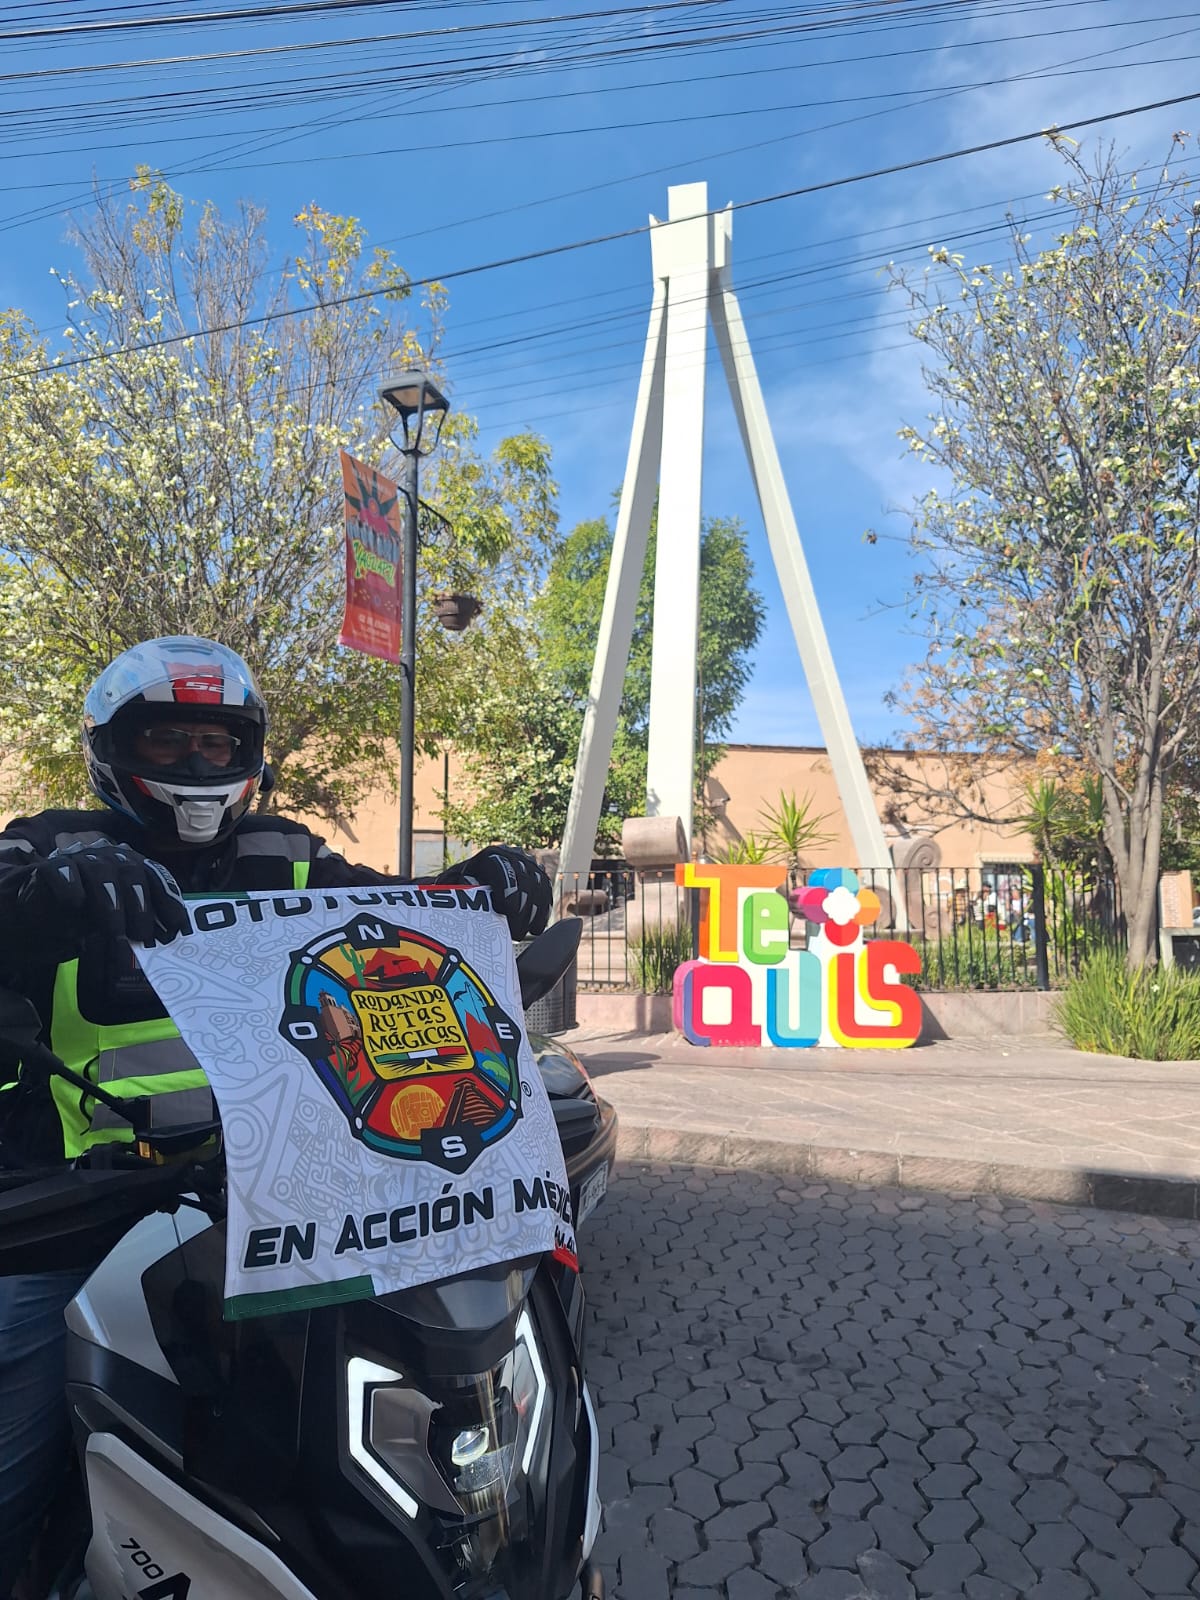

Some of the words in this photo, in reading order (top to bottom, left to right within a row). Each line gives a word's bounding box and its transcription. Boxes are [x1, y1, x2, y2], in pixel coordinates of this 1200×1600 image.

[674, 863, 788, 964] Te
[357, 924, 385, 941] N
[292, 1021, 318, 1039] O
[494, 1022, 515, 1040] E
[441, 1135, 467, 1158] S
[243, 1222, 316, 1269] EN
[334, 1183, 495, 1255] ACCIÓN
[512, 1170, 574, 1225] MÉXIC
[120, 1537, 164, 1579] 700
